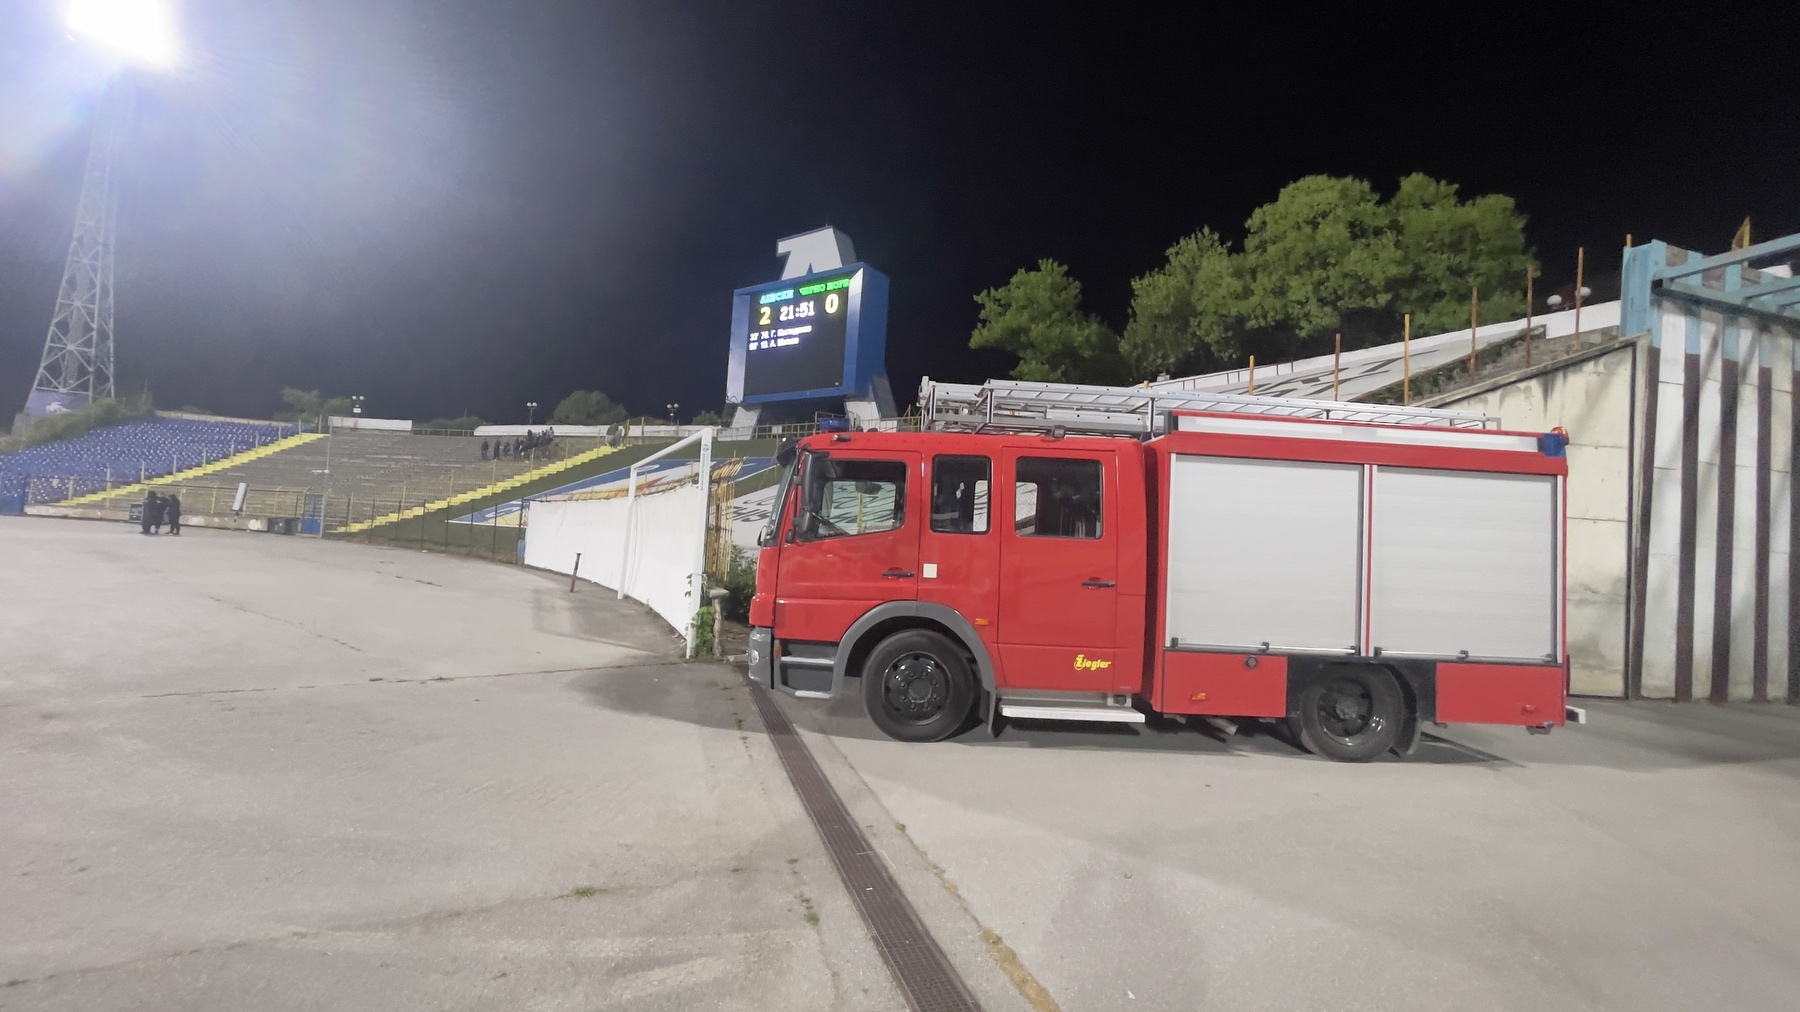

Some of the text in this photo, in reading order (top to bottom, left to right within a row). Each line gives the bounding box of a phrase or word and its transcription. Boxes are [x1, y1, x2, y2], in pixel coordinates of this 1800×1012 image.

[759, 293, 839, 326] 2 21:51 0
[1074, 654, 1112, 671] Ziegler
